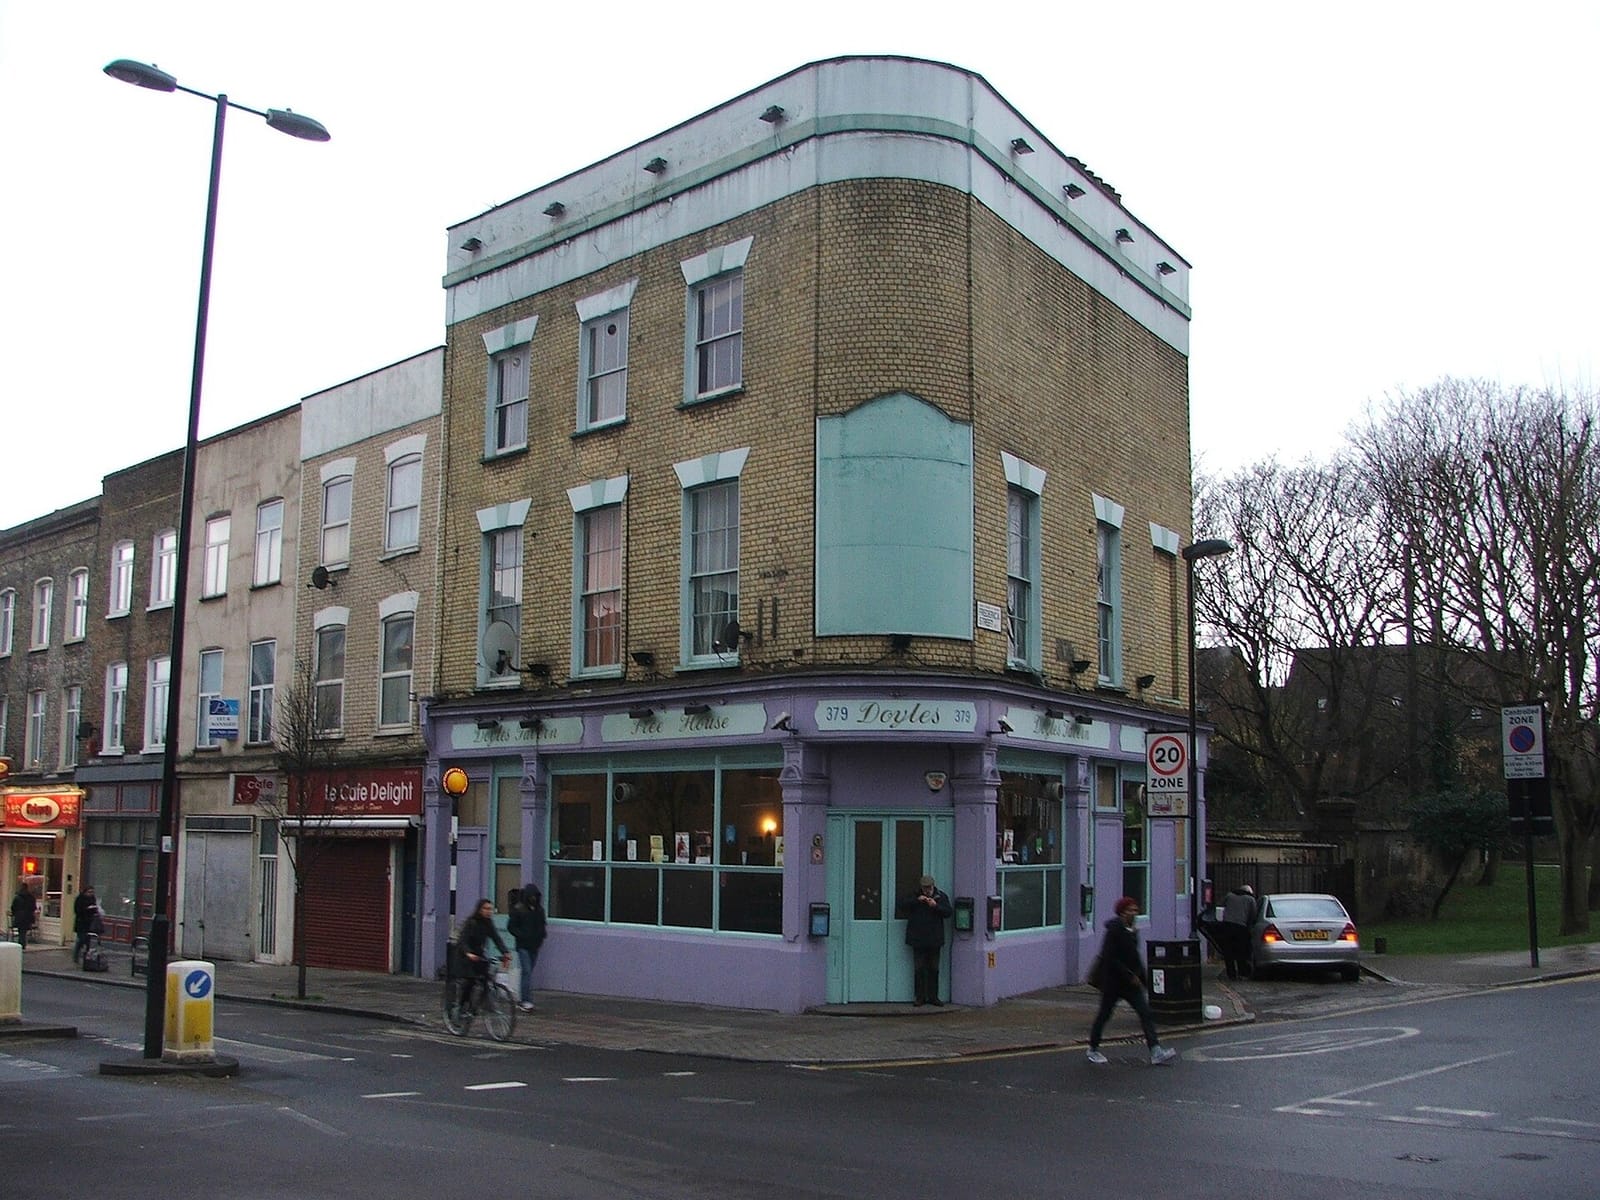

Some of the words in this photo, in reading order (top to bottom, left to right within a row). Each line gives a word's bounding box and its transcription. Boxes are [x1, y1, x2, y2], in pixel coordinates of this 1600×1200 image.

[826, 706, 848, 722] 379
[856, 701, 940, 729] Doyles
[954, 709, 971, 724] 379
[1509, 715, 1534, 725] ZONE
[679, 714, 730, 733] House
[1155, 747, 1180, 763] 20
[247, 779, 274, 790] cafe
[1151, 777, 1184, 788] ZONE
[324, 783, 338, 802] Le
[340, 782, 368, 801] Cafe
[370, 781, 414, 806] Delight
